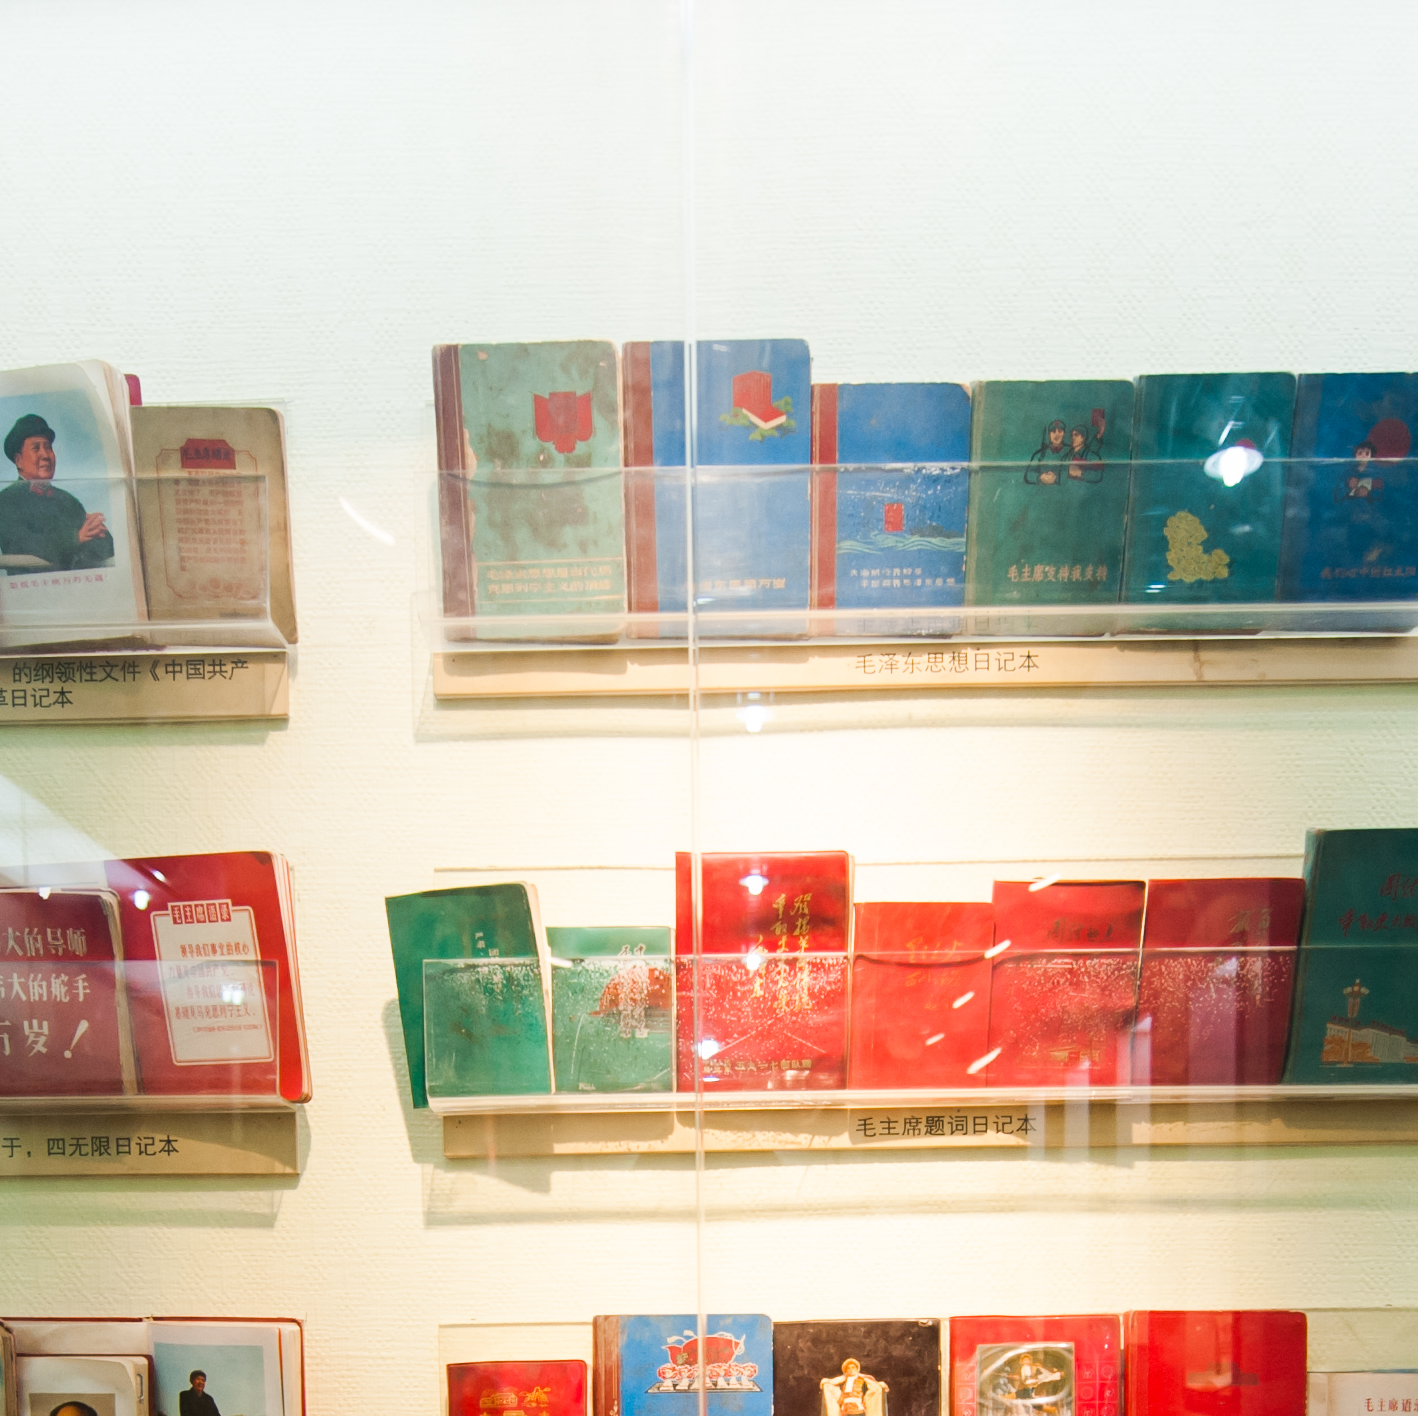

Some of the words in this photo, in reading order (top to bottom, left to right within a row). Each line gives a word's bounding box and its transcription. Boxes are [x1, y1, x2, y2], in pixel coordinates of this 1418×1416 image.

[855, 649, 1040, 677] 毛泽东思想日记本
[172, 903, 229, 923] 毛主席语录
[855, 1114, 1037, 1138] 毛主席题词日记本
